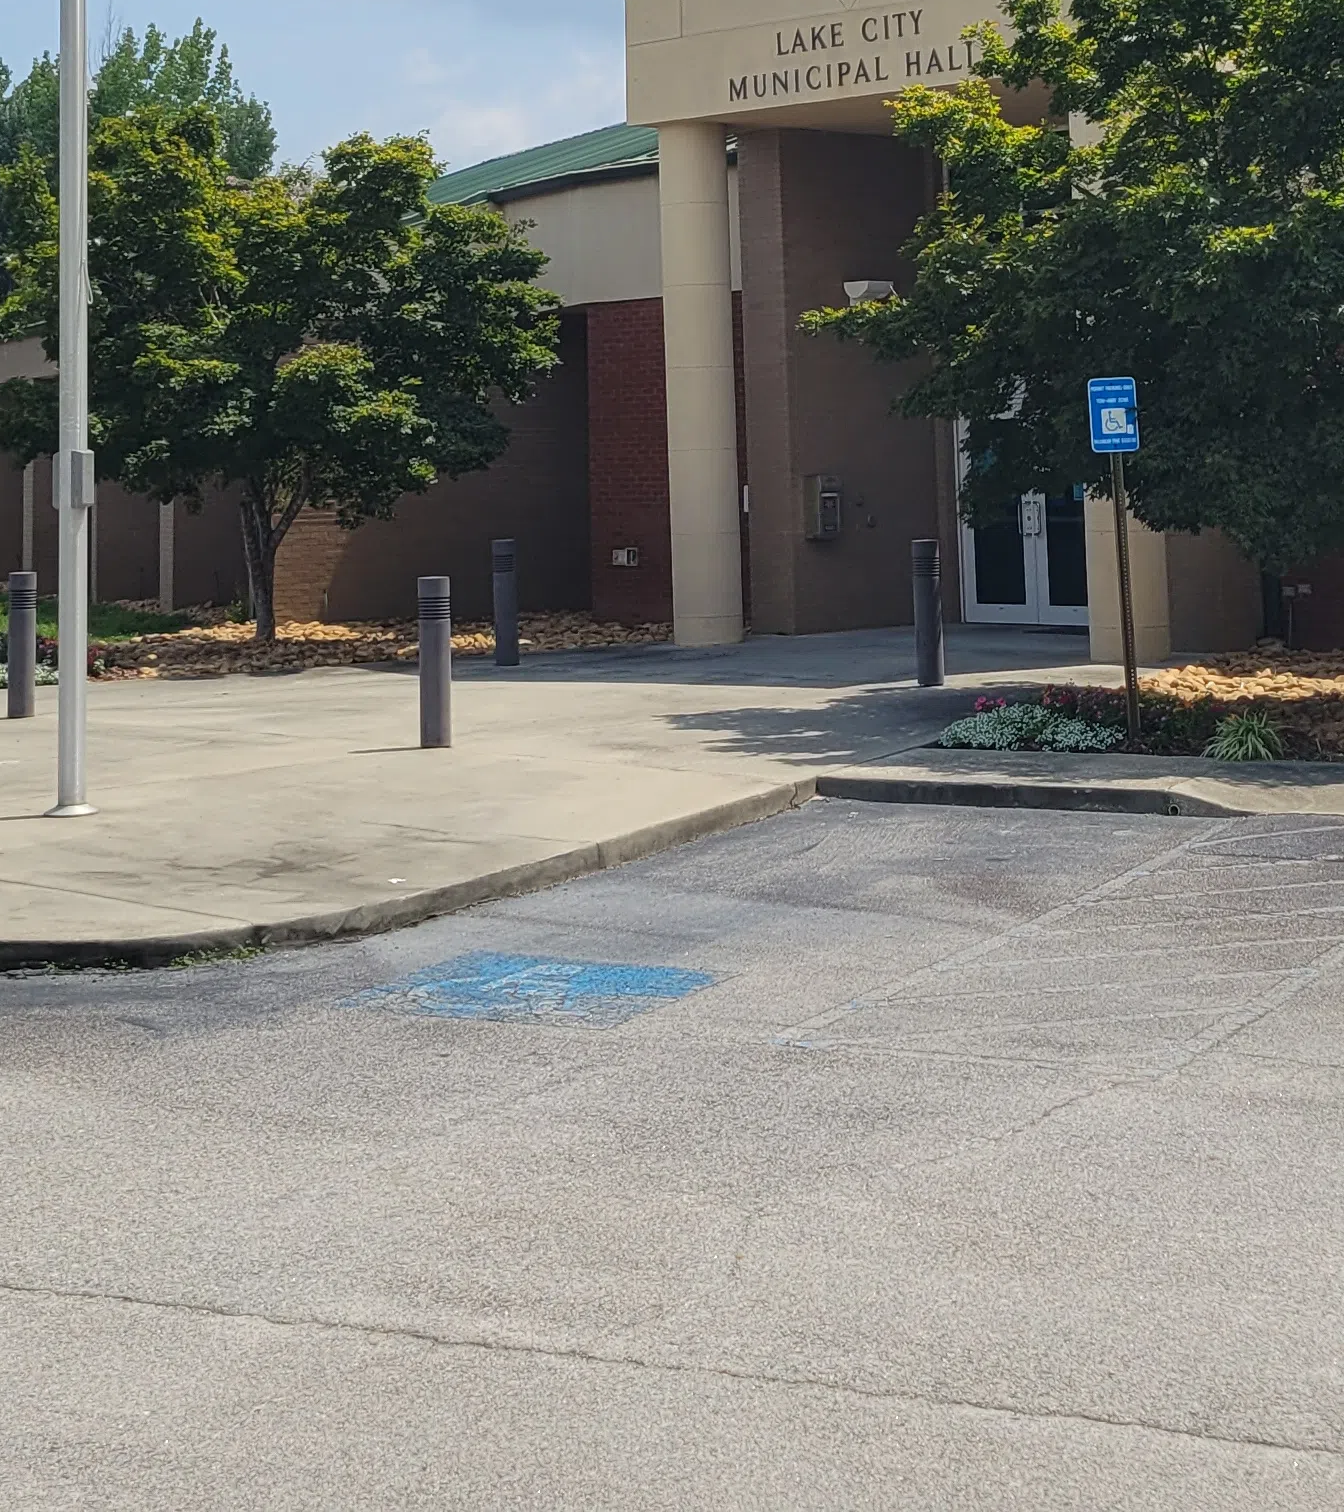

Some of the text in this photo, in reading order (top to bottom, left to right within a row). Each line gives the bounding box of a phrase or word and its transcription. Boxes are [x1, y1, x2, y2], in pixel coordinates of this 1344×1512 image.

[776, 9, 924, 56] LAKE CITY
[728, 55, 889, 102] MUNICIPAL
